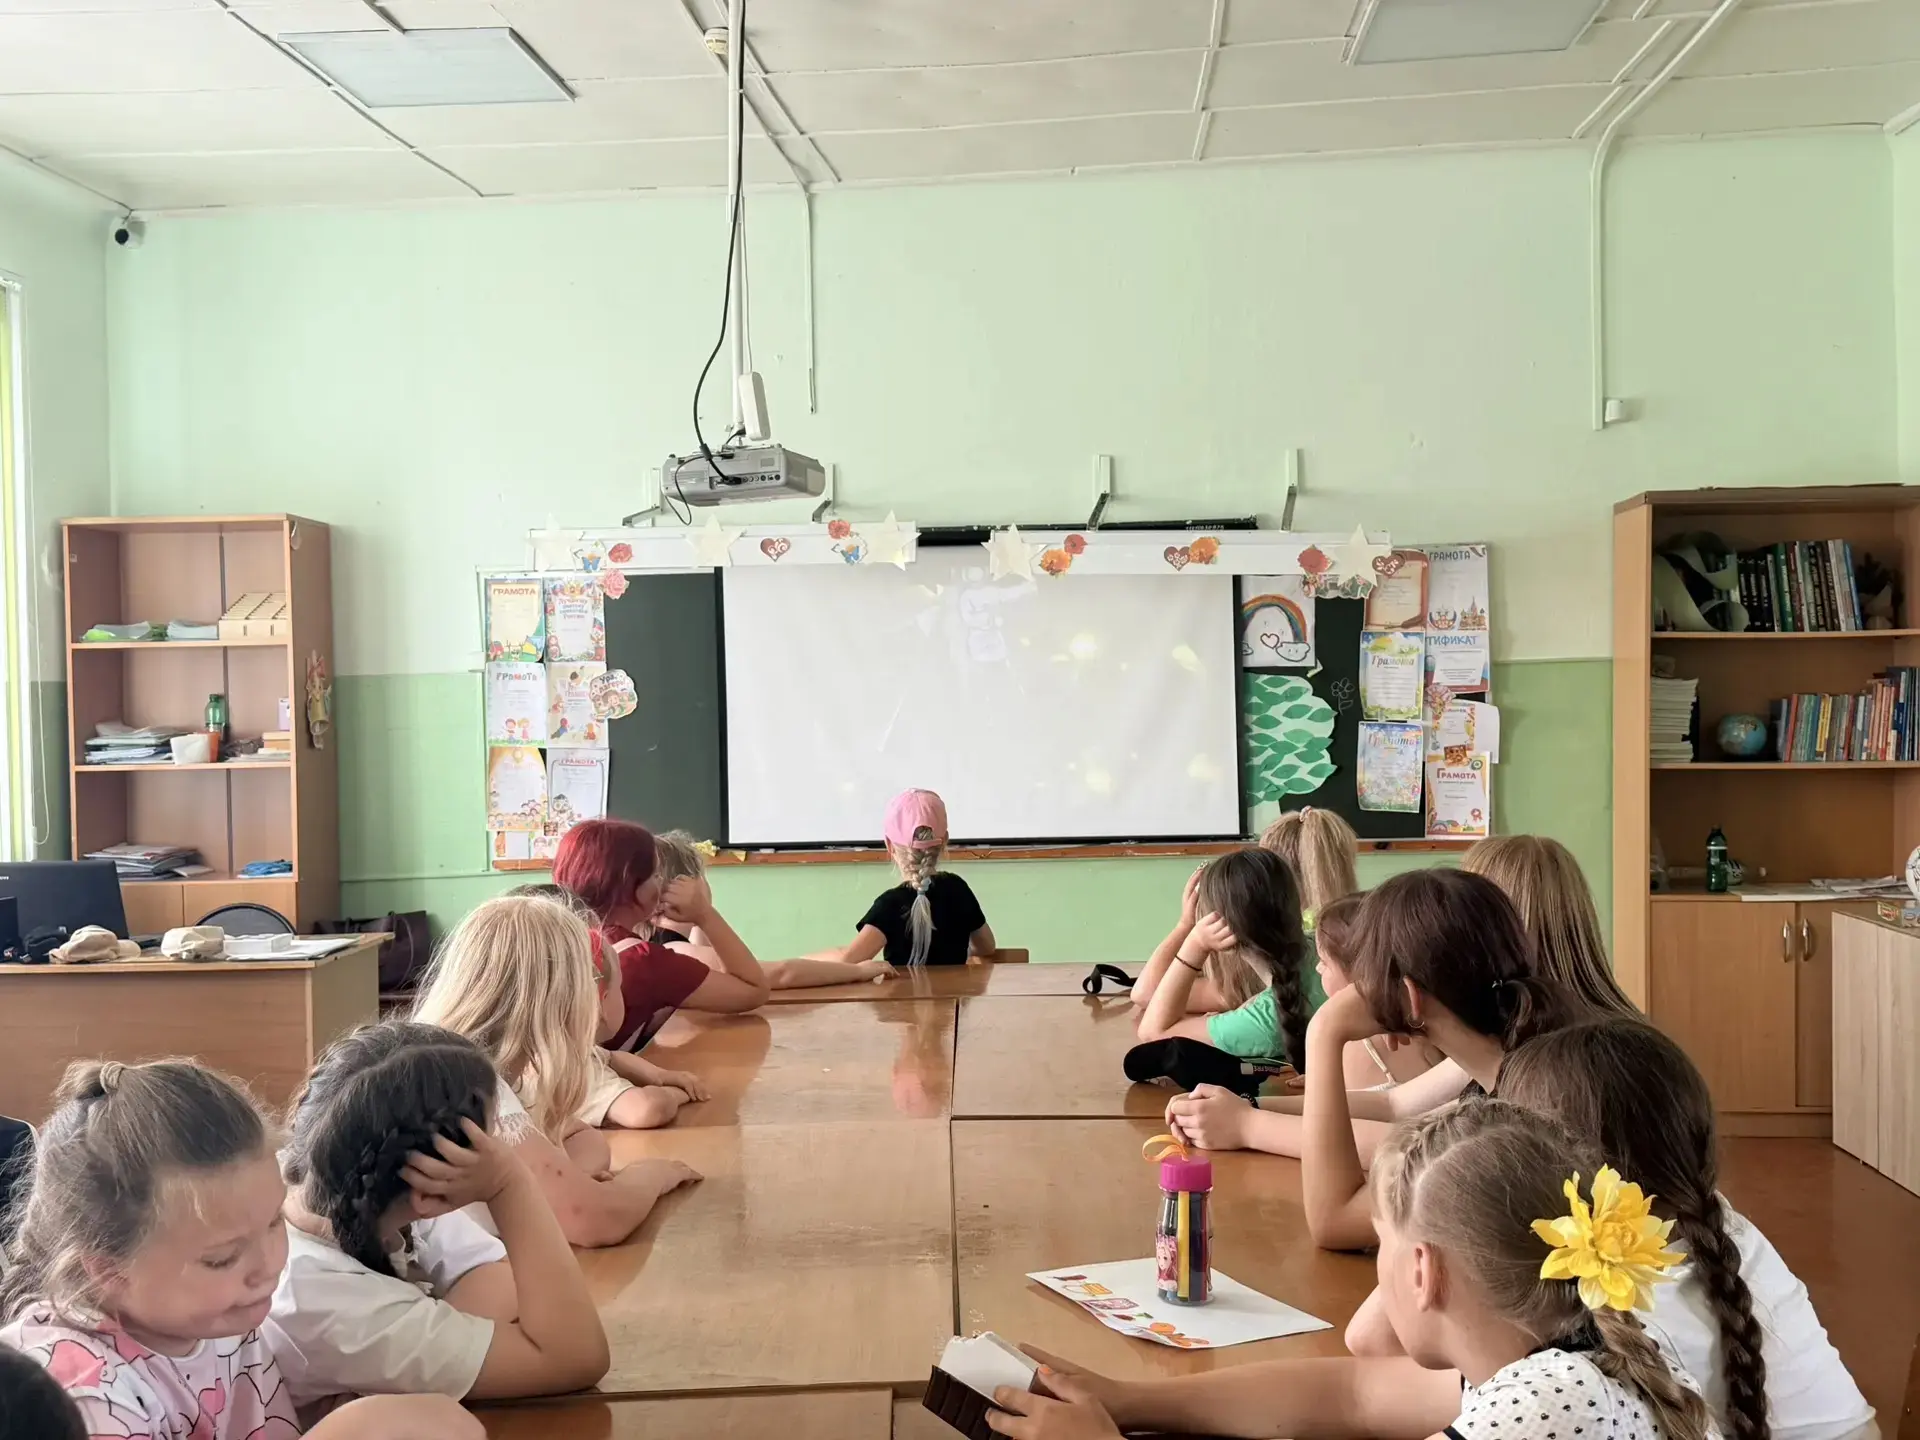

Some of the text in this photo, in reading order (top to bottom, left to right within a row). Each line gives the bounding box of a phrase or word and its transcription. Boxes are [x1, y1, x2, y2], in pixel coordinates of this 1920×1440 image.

[1429, 550, 1471, 561] ГРАМОТА
[493, 587, 536, 595] ГРАМОТА
[1426, 635, 1478, 646] ТИФИКАТ
[1371, 655, 1415, 668] Грамота
